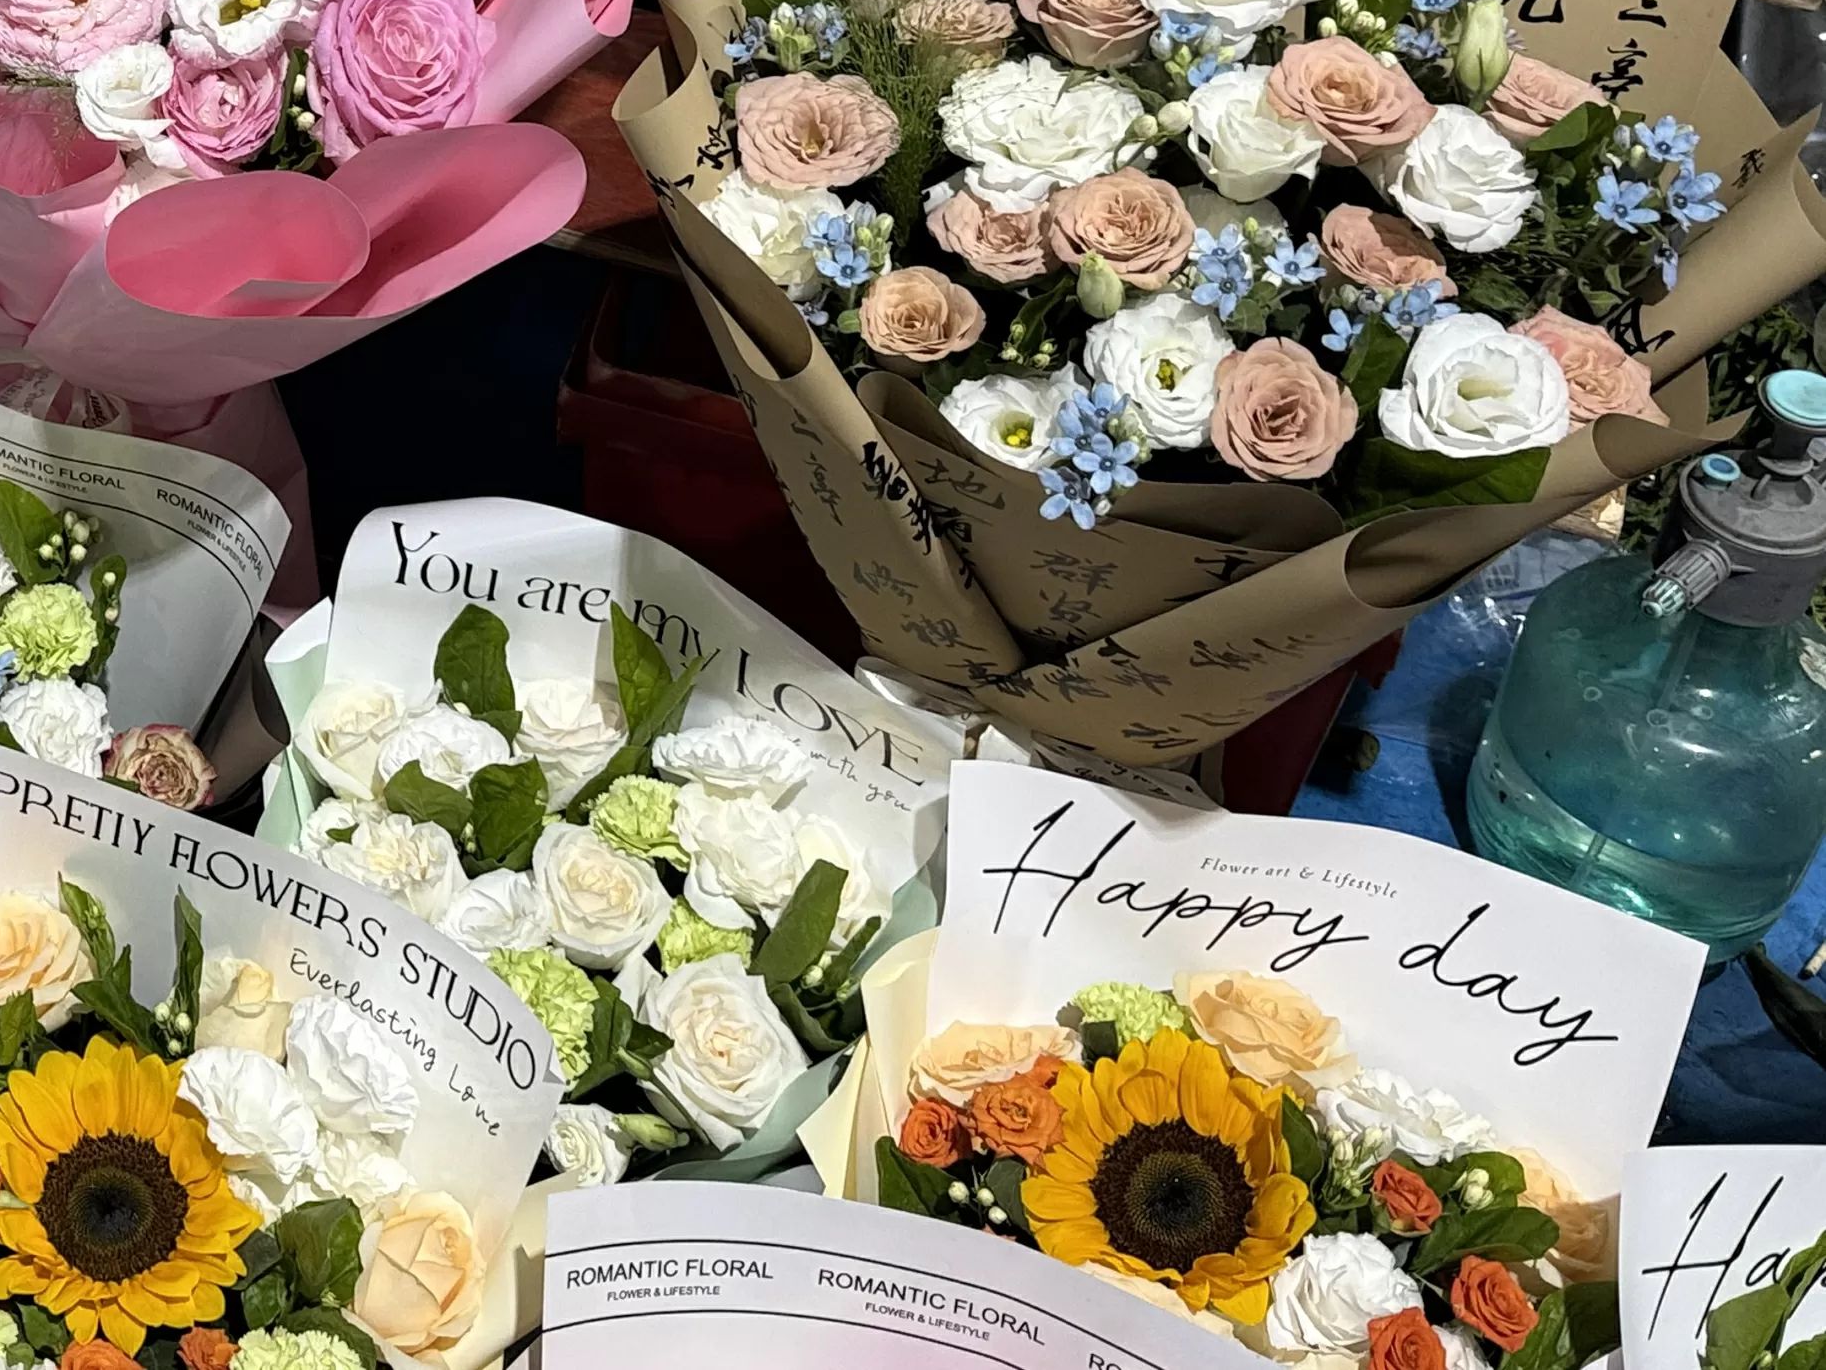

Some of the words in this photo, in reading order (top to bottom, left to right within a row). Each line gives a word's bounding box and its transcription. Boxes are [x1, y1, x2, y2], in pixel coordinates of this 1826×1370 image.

[59, 466, 126, 490] FLORAL
[156, 488, 234, 538] ROMANTIC
[235, 532, 262, 581] FLORAL
[390, 521, 498, 602] You
[517, 576, 611, 623] are
[633, 599, 721, 673] my
[735, 647, 925, 786] LOVE
[810, 751, 858, 782] with
[865, 783, 911, 812] you
[1200, 857, 1259, 876] Flower
[1264, 864, 1291, 877] art
[1298, 865, 1315, 879] &
[1321, 868, 1399, 900] Lifestyle
[168, 831, 387, 959] FLOWERS
[400, 942, 537, 1091] STUDIO
[982, 800, 1369, 973] Happy
[1398, 903, 1619, 1066] day
[289, 947, 436, 1072] Everlasting
[567, 1259, 678, 1290] ROMANTIC
[684, 1258, 773, 1280] FLORAL
[607, 1287, 652, 1301] FLOWER
[653, 1287, 661, 1297] &
[663, 1285, 720, 1296] LIFESTYLE
[818, 1268, 946, 1311] ROMANTIC
[953, 1297, 1046, 1346] FLORAL
[865, 1302, 915, 1321] FLOWER
[917, 1312, 926, 1322] &
[927, 1315, 990, 1341] LIFESTYLE
